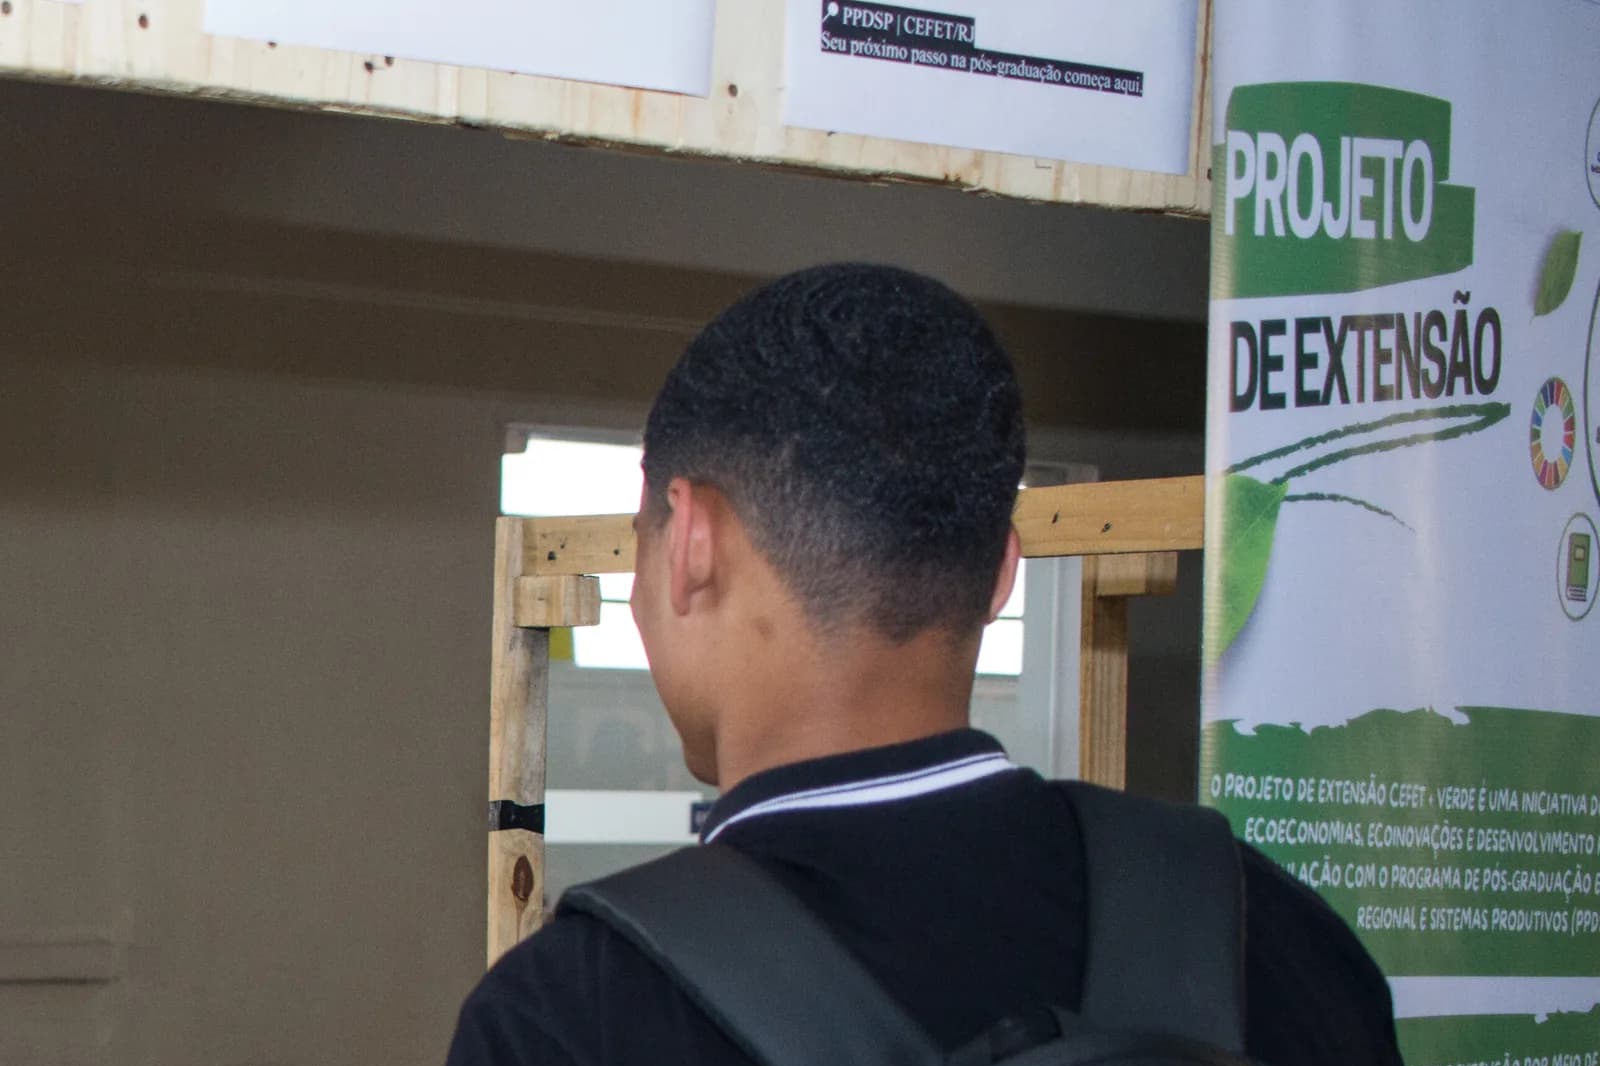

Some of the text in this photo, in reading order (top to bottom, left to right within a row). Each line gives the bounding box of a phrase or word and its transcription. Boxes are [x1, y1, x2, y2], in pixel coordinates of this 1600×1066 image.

[843, 7, 893, 31] PPDSP
[904, 16, 974, 43] CEFET/RJ
[822, 31, 1143, 96] Seu próximo passo na pós-graduação começa aqui.
[1225, 130, 1434, 242] PROJETO
[1229, 290, 1501, 413] DE EXTENSÃO
[1210, 774, 1222, 798] O
[1224, 773, 1294, 800] PROJETO
[1298, 777, 1315, 802] DE
[1318, 773, 1387, 806] EXTENSÃO
[1389, 782, 1426, 808] CEFET
[1437, 786, 1476, 811] VERDE
[1489, 788, 1519, 812] UMA
[1522, 791, 1587, 816] INICIATIVA
[1368, 819, 1463, 860] ECOINOVAÇÕES
[1466, 827, 1475, 851] E
[1477, 828, 1594, 855] DESENVOLVIMENTO
[1345, 863, 1376, 888] COM
[1379, 865, 1388, 888] O
[1391, 864, 1461, 889] PROGRAMA
[1464, 868, 1481, 891] DE
[1483, 862, 1592, 904] PÓS-GRADUAÇÃO
[1357, 905, 1600, 936] REGIONAL E SISTEMAS PRODUTIVOS (PPD
